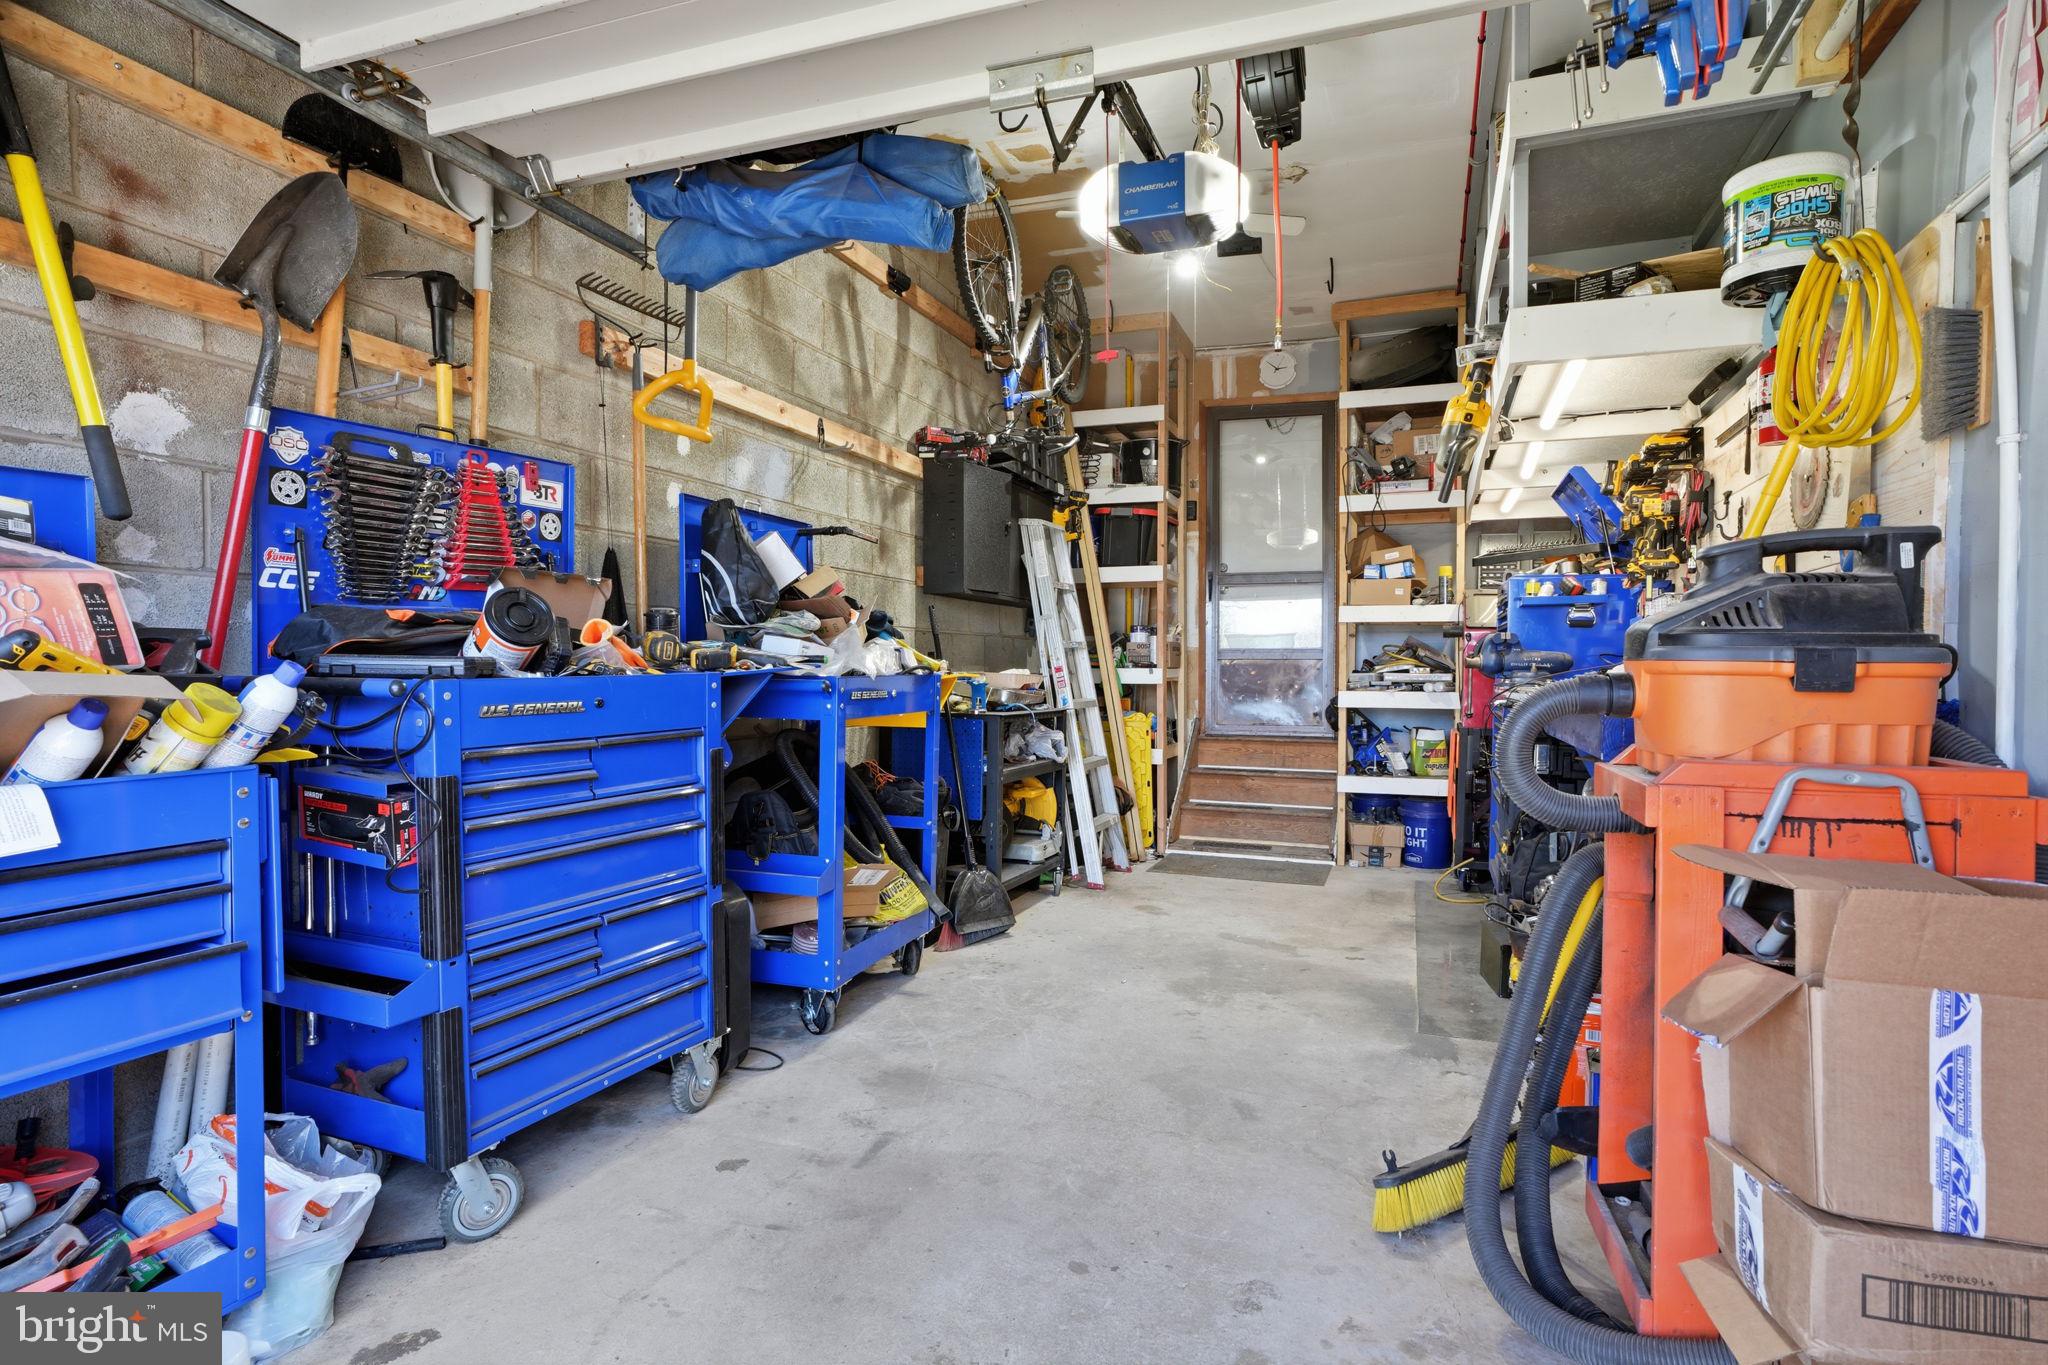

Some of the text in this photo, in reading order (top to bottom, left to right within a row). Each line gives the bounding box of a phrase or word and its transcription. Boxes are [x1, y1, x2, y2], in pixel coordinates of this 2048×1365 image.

[1124, 180, 1178, 194] CHAMBERLAIN
[1774, 196, 1831, 219] SHOP
[511, 700, 586, 717] GENERAL
[1415, 827, 1427, 837] IT
[1406, 837, 1427, 848] GHT
[1956, 1056, 1965, 1127] ROCKAUTO.COM
